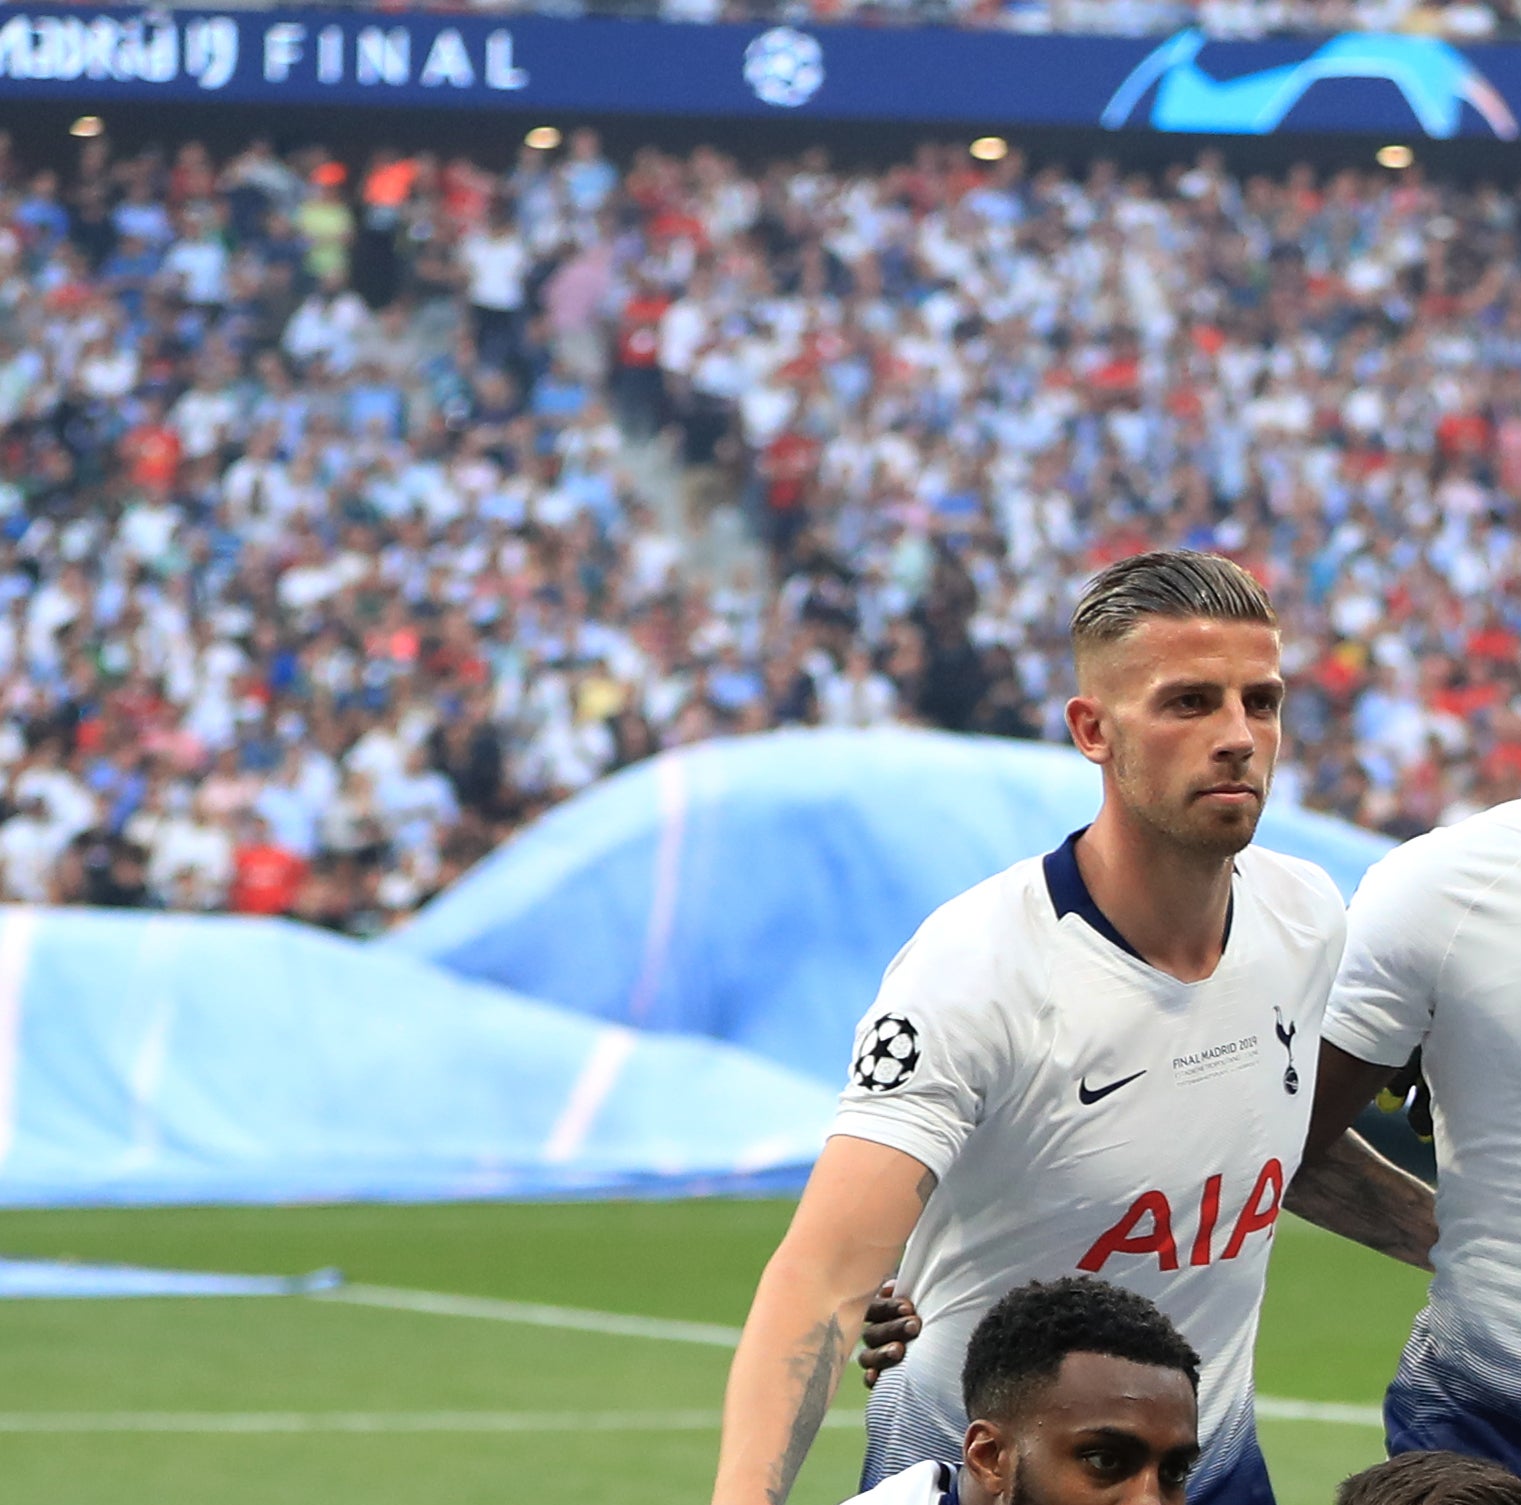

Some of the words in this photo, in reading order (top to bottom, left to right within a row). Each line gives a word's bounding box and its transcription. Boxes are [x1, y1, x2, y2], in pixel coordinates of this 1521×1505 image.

[263, 22, 532, 89] FINAL
[1173, 1053, 1201, 1069] FINAL
[1201, 1042, 1237, 1060] MADRID
[1239, 1035, 1258, 1051] 2019
[1076, 1157, 1283, 1272] AIA
